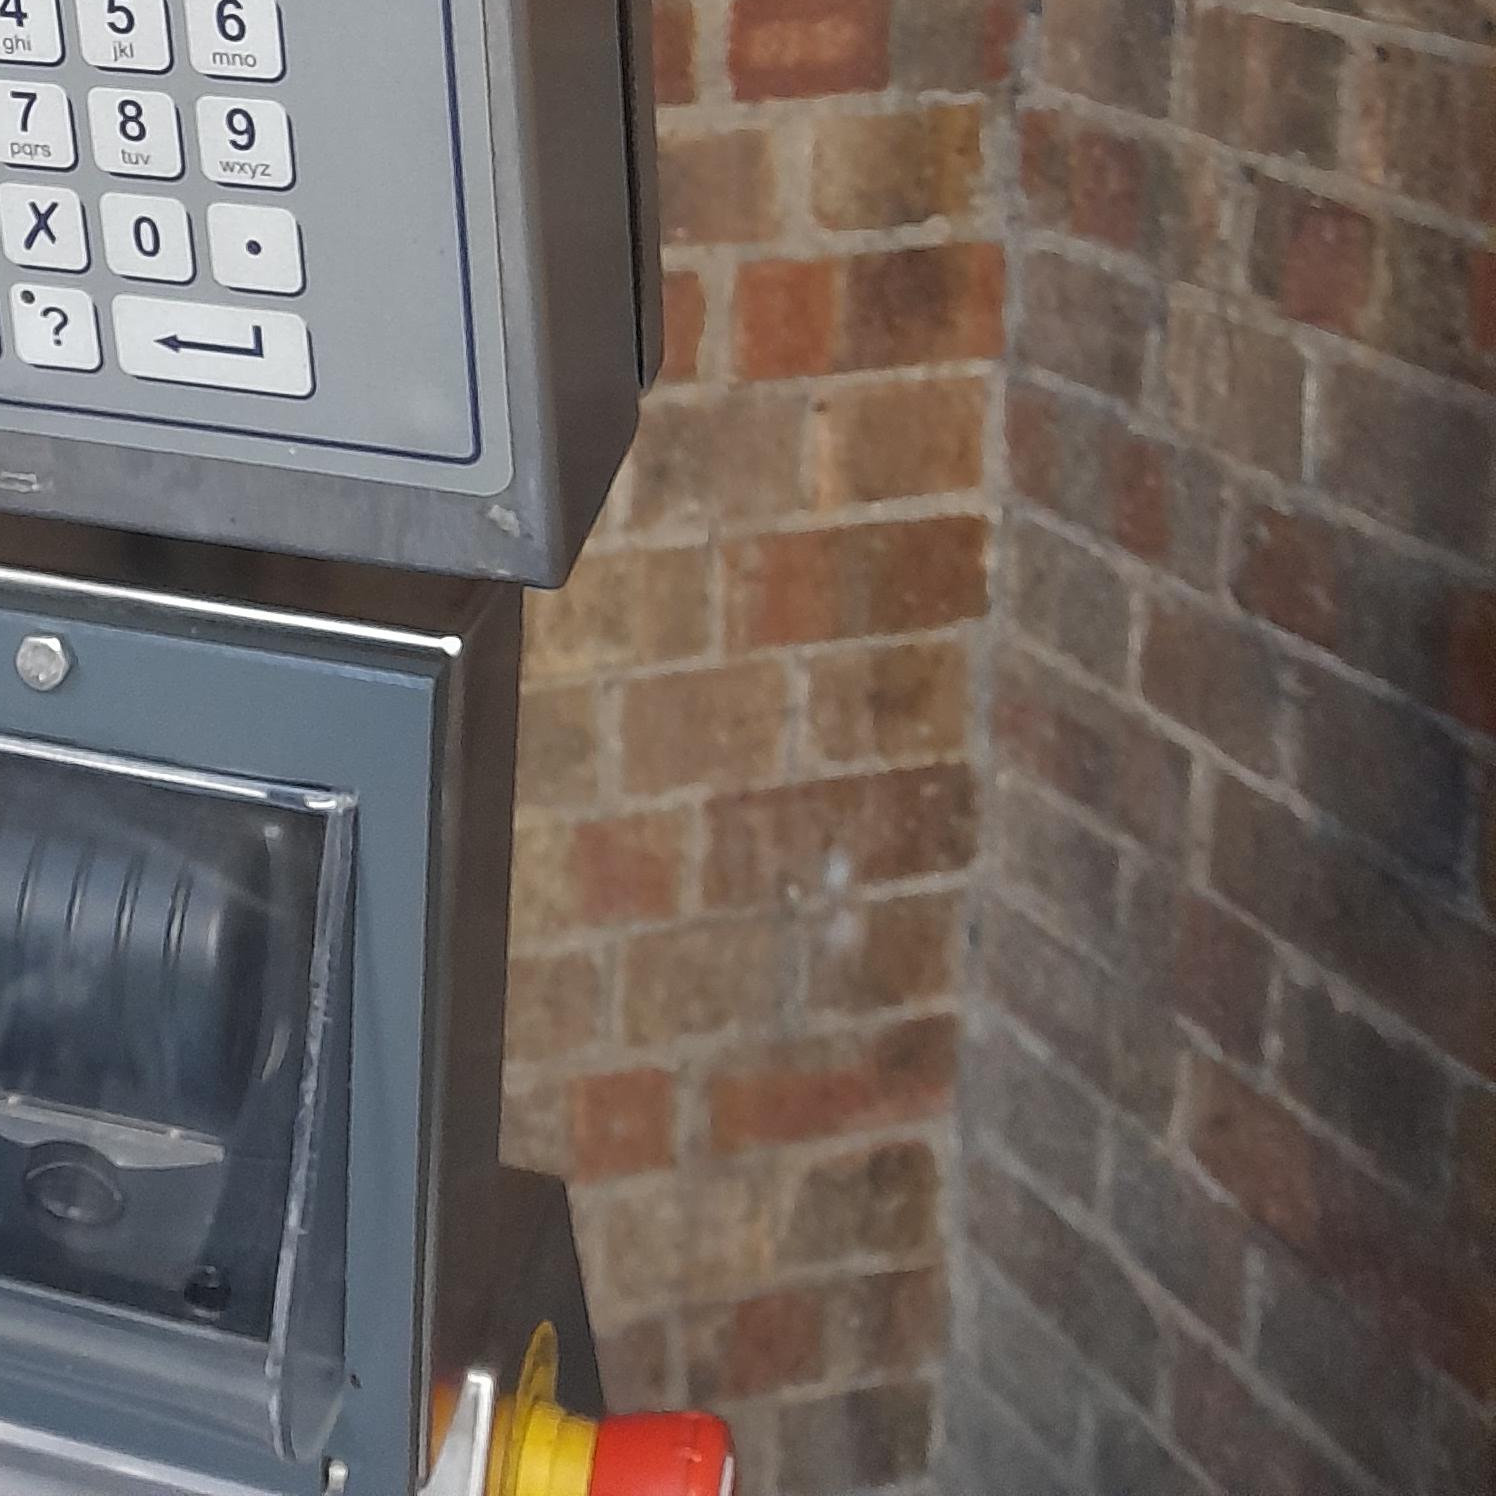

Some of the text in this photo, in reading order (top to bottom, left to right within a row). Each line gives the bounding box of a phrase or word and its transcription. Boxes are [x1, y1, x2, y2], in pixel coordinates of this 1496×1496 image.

[3, 35, 32, 54] ghi
[113, 41, 134, 62] jkl
[212, 52, 256, 67] mno
[10, 91, 37, 132] 7
[118, 99, 146, 142] 8
[226, 108, 256, 151] 9
[10, 142, 51, 159] pqrs
[121, 149, 150, 165] tuv
[219, 161, 272, 179] wxyz
[133, 216, 160, 257] 0
[40, 307, 69, 346] ?
